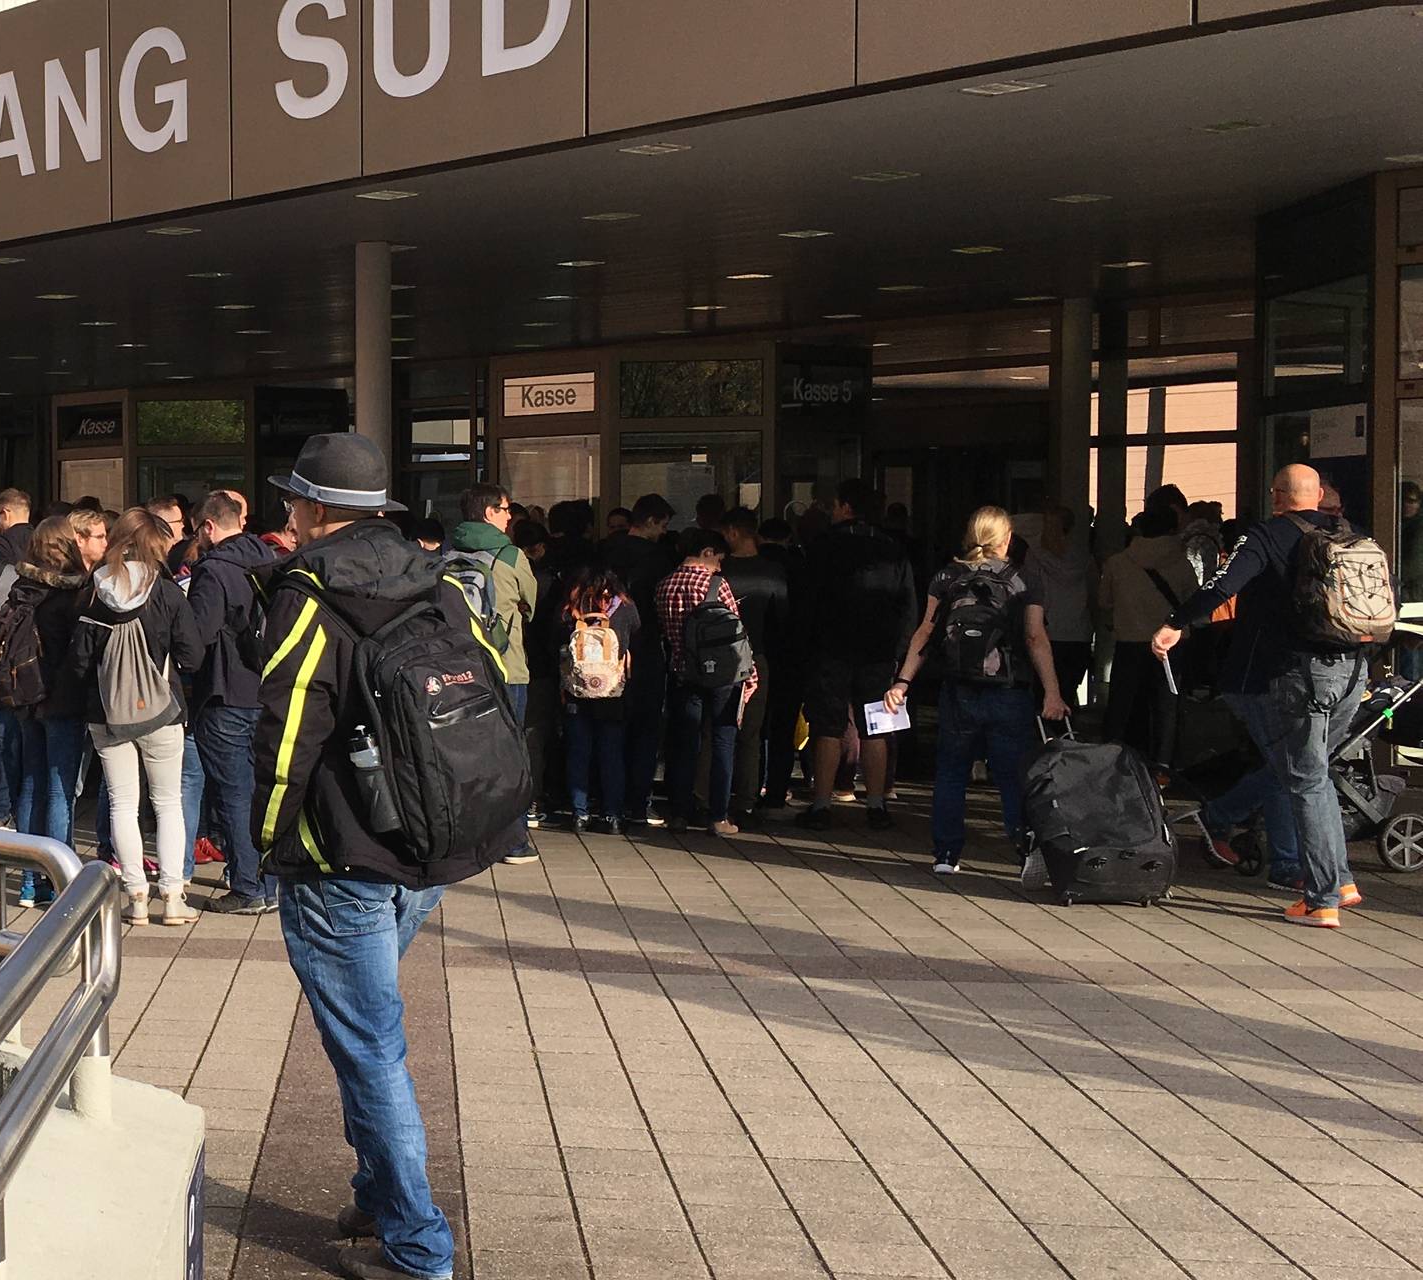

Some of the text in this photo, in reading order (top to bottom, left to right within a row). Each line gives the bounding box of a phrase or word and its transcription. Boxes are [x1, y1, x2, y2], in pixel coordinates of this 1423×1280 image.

[521, 385, 577, 408] Kasse
[793, 376, 852, 404] Kasse 5
[78, 418, 115, 435] Kasse
